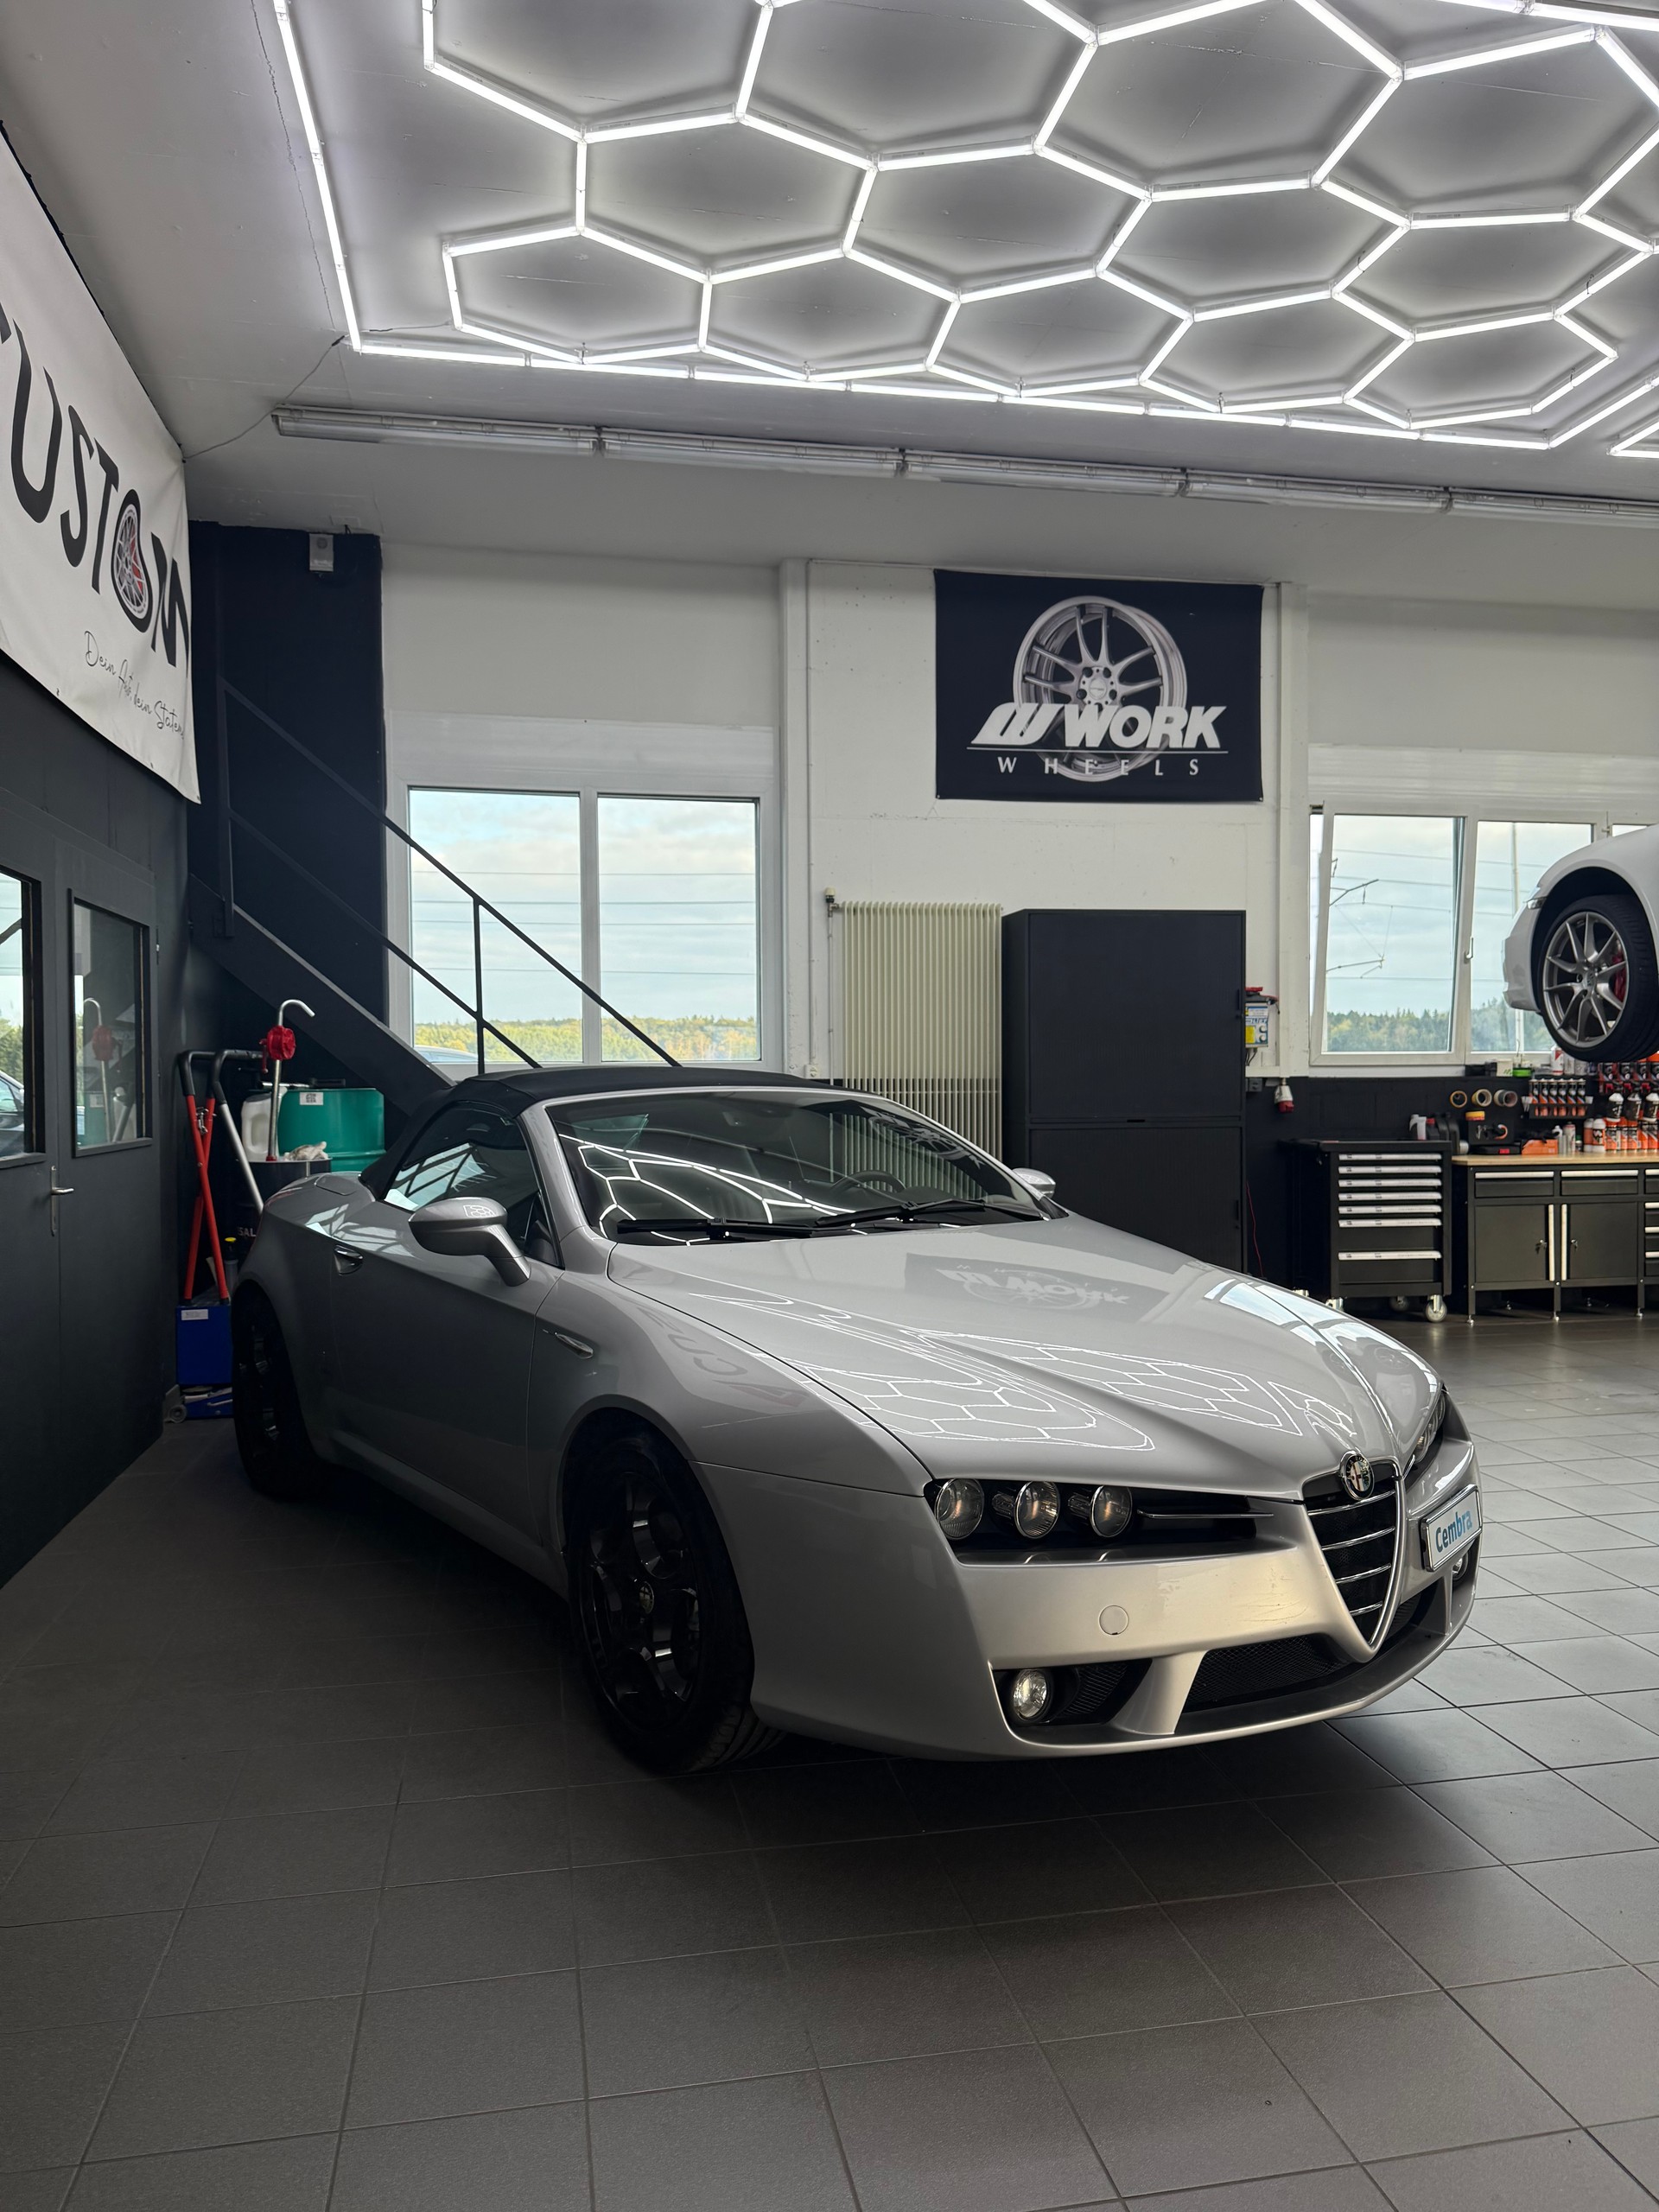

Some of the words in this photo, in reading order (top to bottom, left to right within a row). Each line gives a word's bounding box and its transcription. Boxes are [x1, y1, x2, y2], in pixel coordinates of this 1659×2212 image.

[0, 302, 189, 678] USTOM
[85, 630, 116, 676] Dein
[1064, 704, 1227, 748] WORK
[997, 756, 1199, 777] WHEELS
[1435, 1510, 1473, 1554] Cembra
